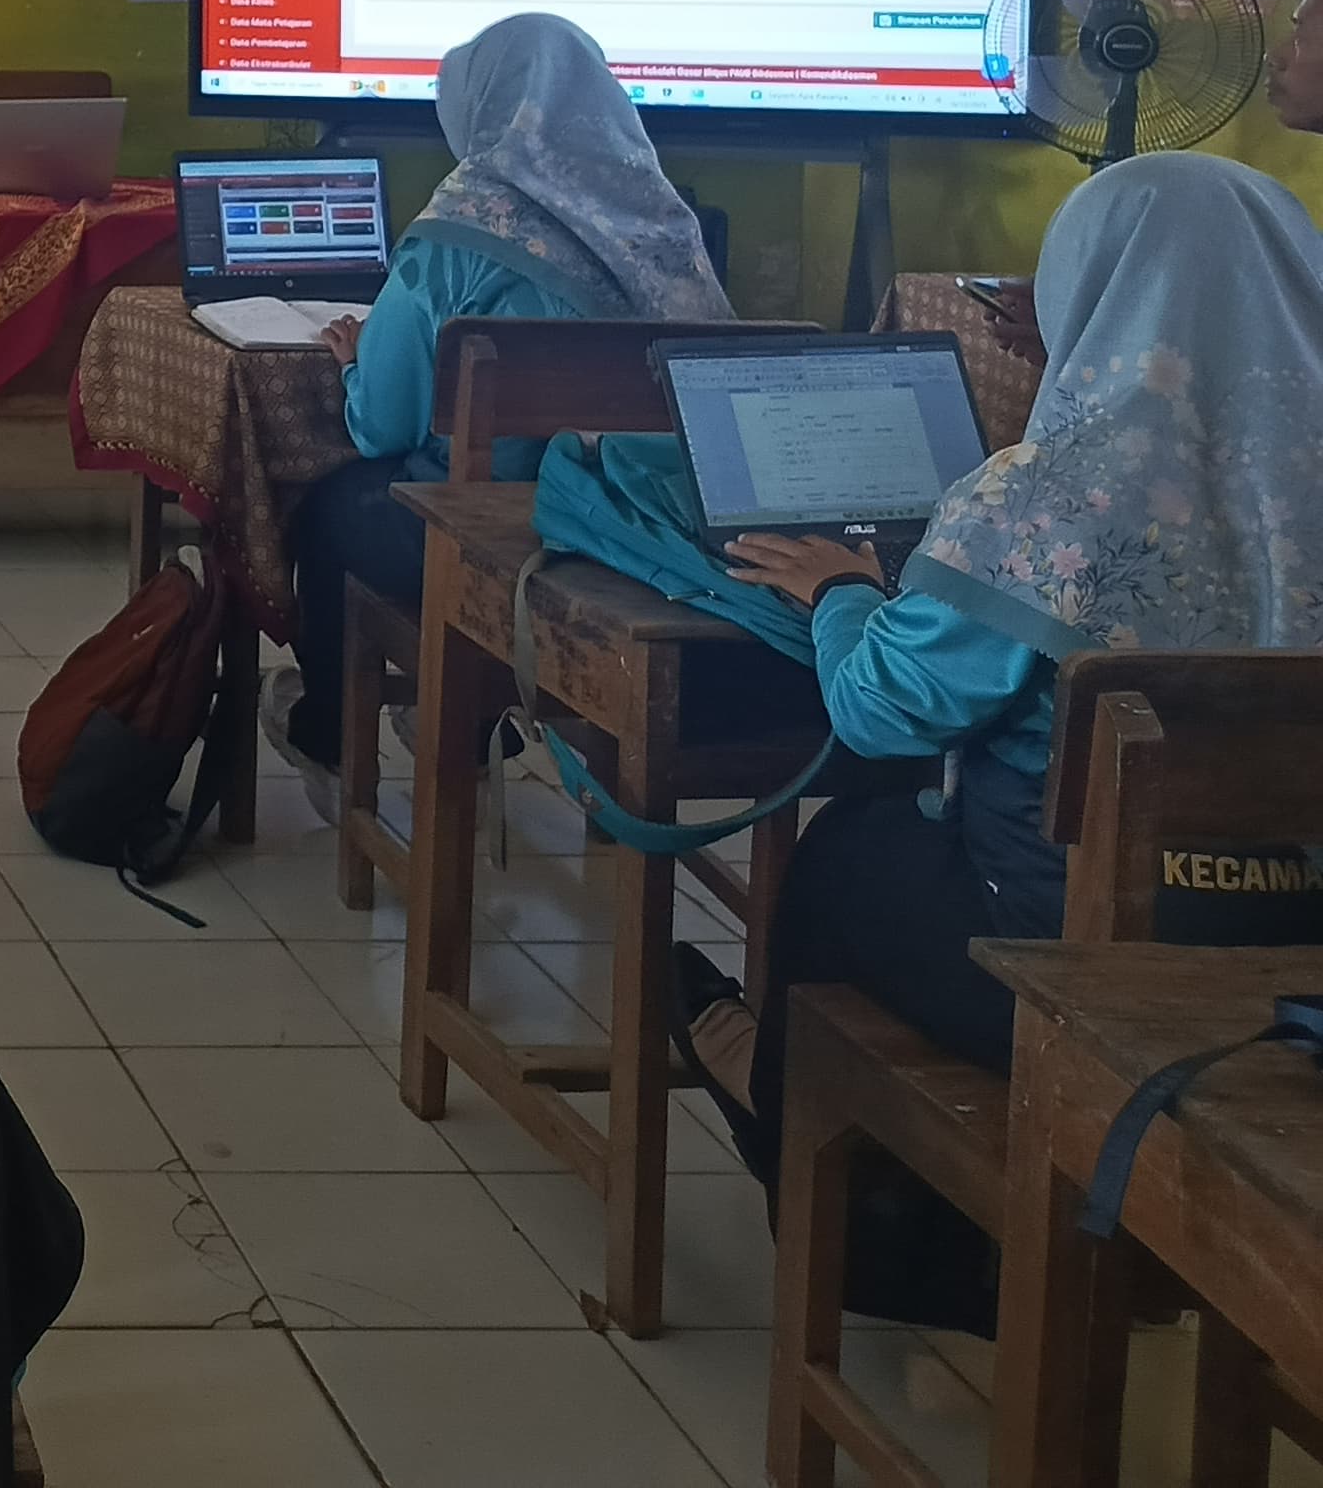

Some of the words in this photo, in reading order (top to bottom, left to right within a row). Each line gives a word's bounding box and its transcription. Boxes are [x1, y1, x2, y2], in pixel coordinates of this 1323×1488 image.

[230, 18, 251, 27] Data
[230, 38, 251, 48] Data
[230, 59, 251, 68] Data
[843, 523, 877, 535] ASUS
